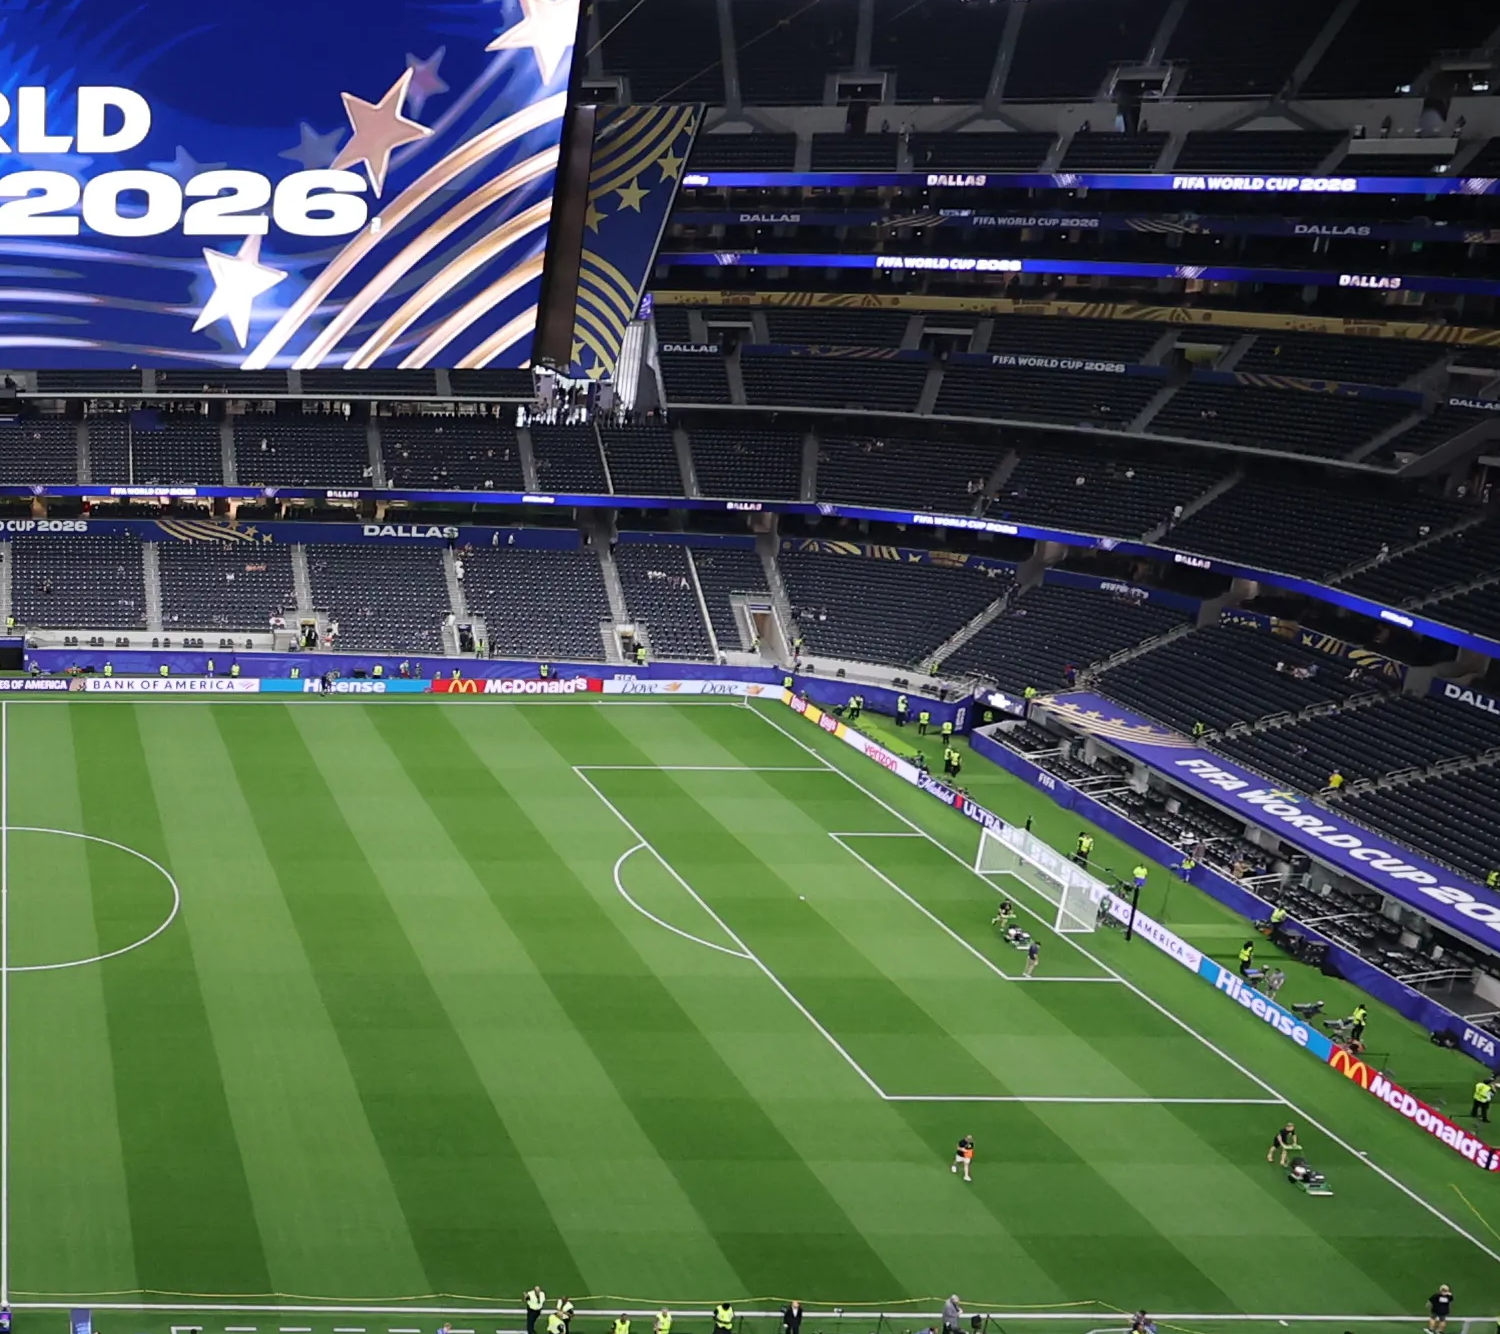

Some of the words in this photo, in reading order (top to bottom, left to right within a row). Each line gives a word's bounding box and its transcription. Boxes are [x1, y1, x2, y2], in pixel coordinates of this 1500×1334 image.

[927, 174, 987, 187] DALLAS
[1173, 177, 1206, 190] FIFA
[1207, 177, 1264, 191] WORLD
[1265, 178, 1299, 192] CUP
[1300, 179, 1357, 193] 2026
[1294, 225, 1371, 236] DALLAS
[1339, 275, 1401, 289] DALLAS
[992, 355, 1016, 365] FIFA
[1018, 357, 1059, 368] WORLD
[1060, 359, 1085, 370] CUP
[1084, 362, 1126, 373] 2026
[6, 521, 35, 532] CUP
[37, 521, 88, 532] 2026
[363, 526, 459, 538] DALLAS
[12, 680, 23, 690] OF
[23, 680, 68, 690] AMERICA
[93, 680, 135, 690] BANK
[141, 680, 158, 690] OF
[164, 680, 235, 690] AMERICA
[484, 676, 587, 693] McDonald's
[620, 681, 657, 694] Dove
[700, 682, 738, 695] Dove
[864, 742, 898, 772] verizon
[1175, 759, 1249, 791] FIFA
[1236, 789, 1362, 848] WORLD
[1348, 847, 1438, 884] CUP
[1215, 967, 1309, 1047] Hisense
[1463, 1028, 1495, 1057] FIFA
[1370, 1075, 1500, 1171] McDonald's
